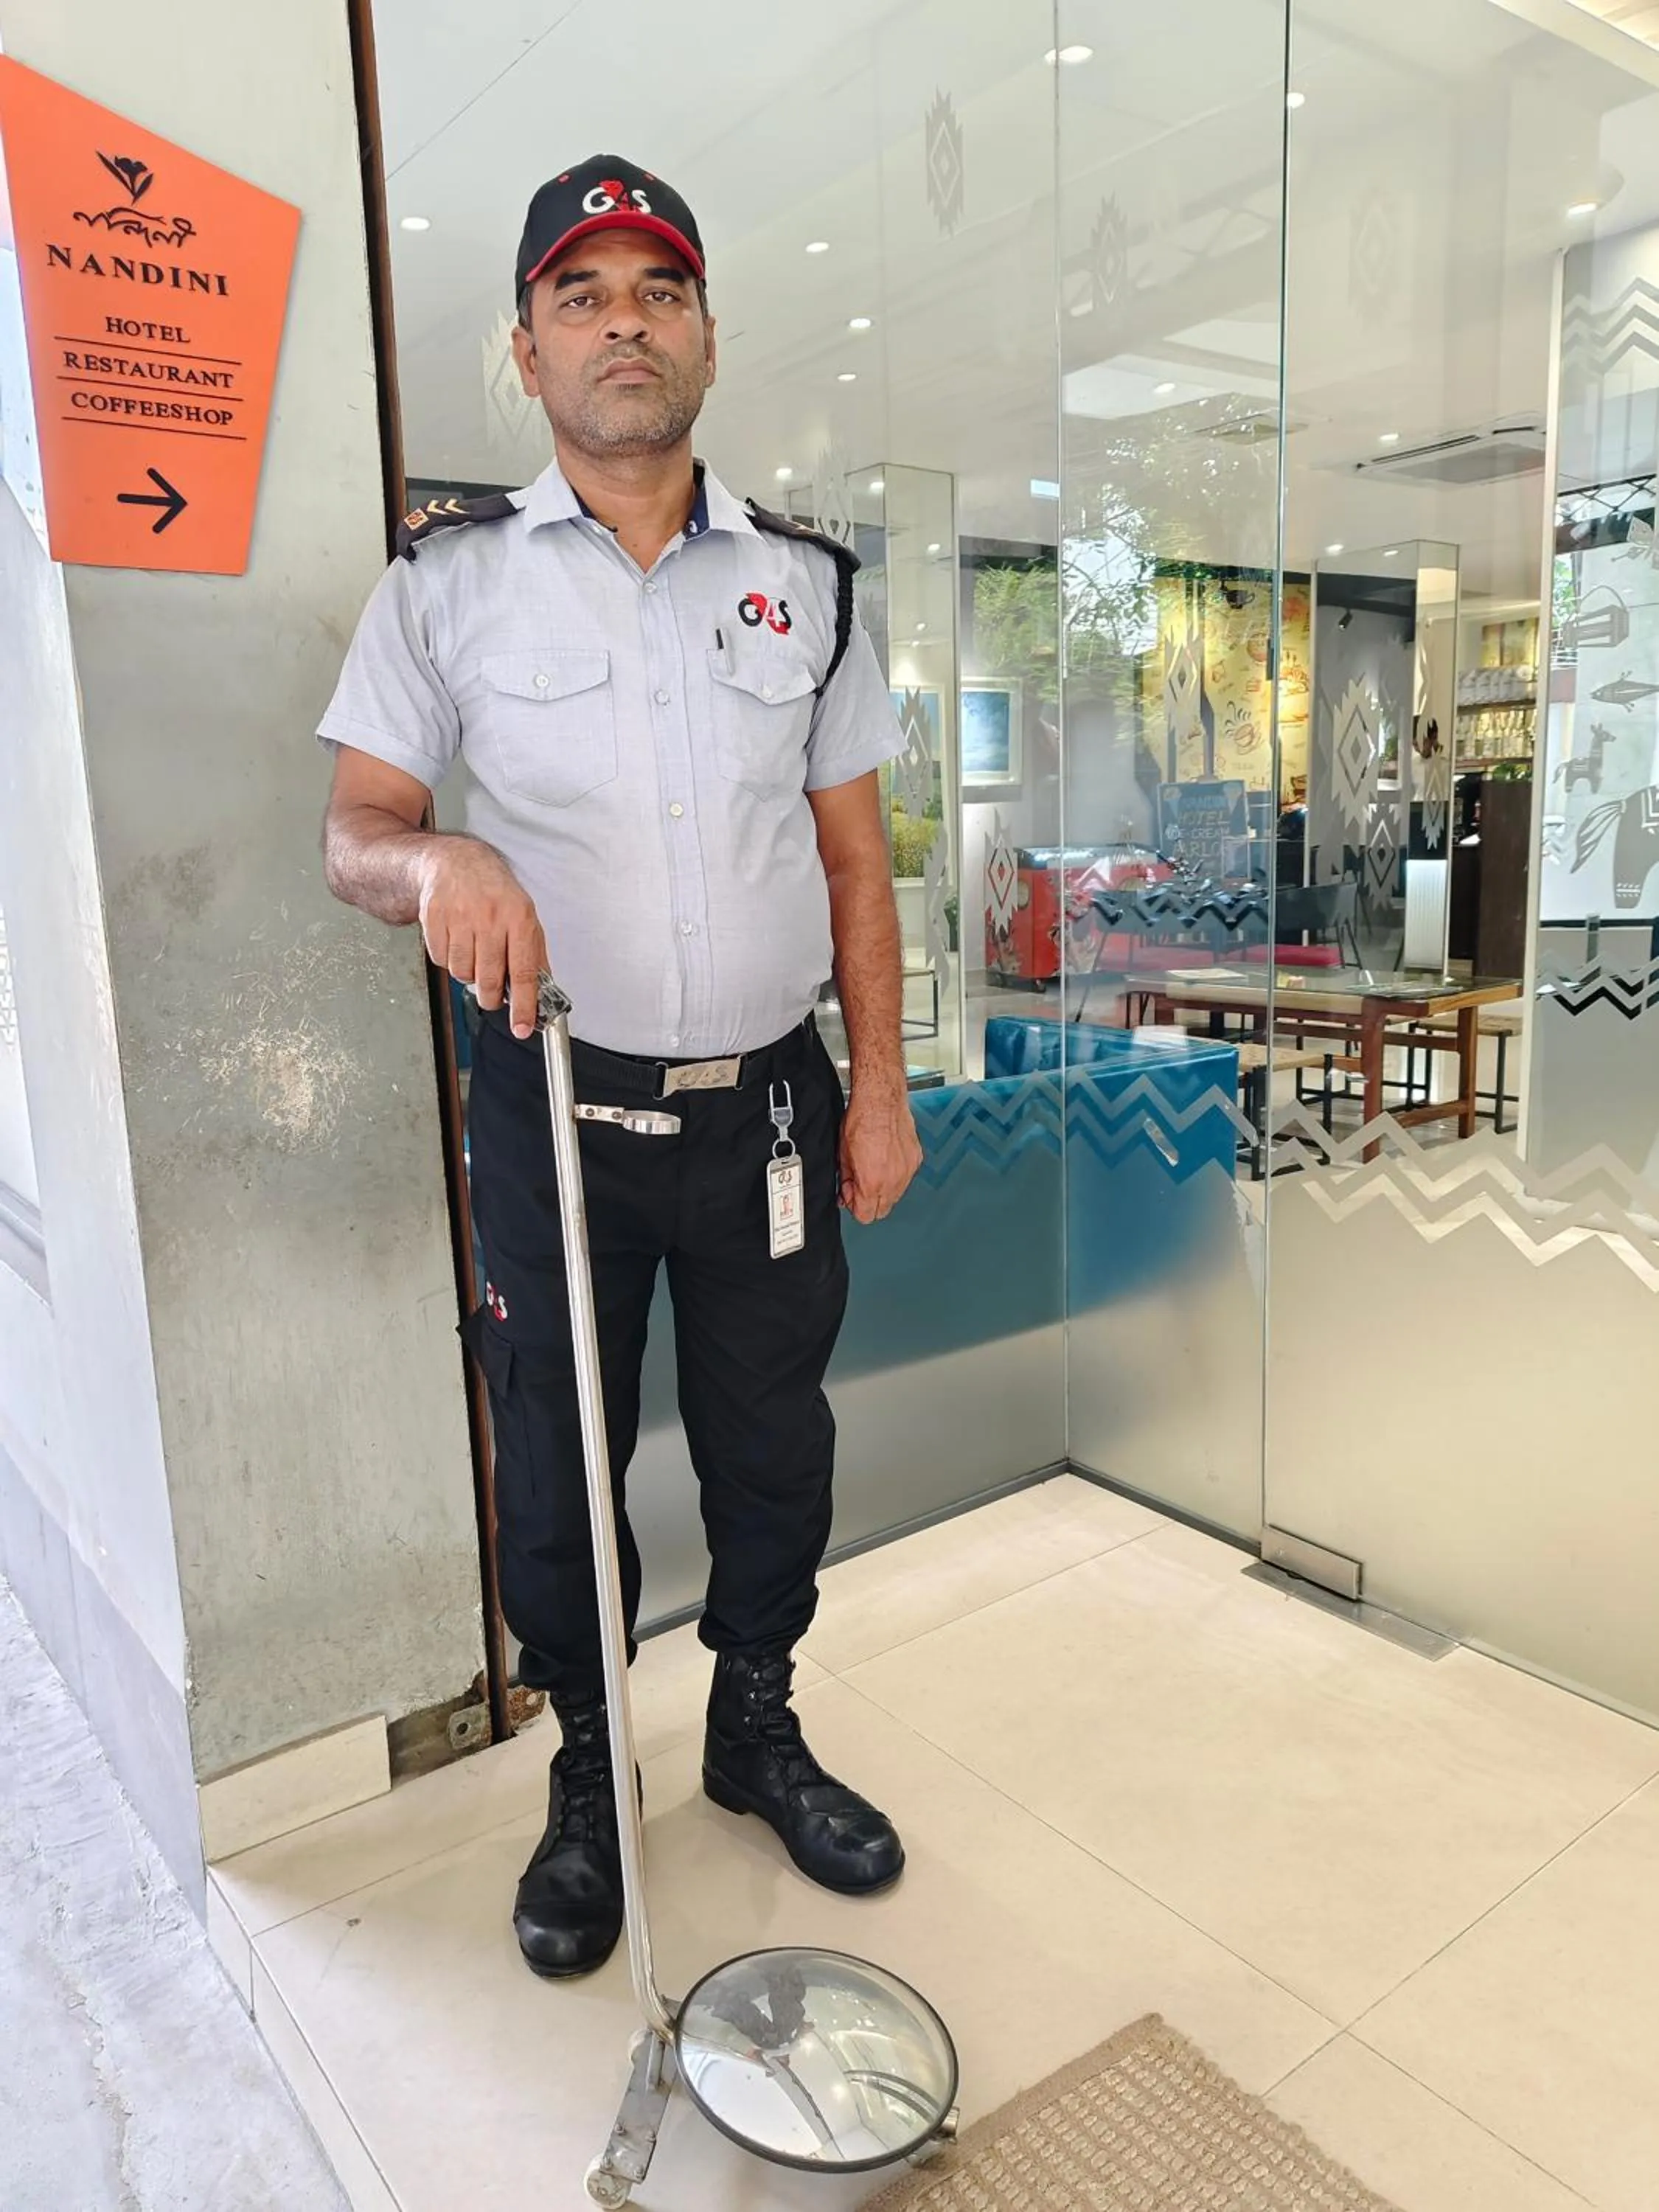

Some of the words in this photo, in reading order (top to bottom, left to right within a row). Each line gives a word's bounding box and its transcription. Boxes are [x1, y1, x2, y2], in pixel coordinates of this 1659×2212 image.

[46, 244, 229, 296] NANDINI
[105, 316, 191, 344] HOTEL
[63, 351, 234, 389] RESTAURANT
[71, 392, 233, 425] COFFEESHOP
